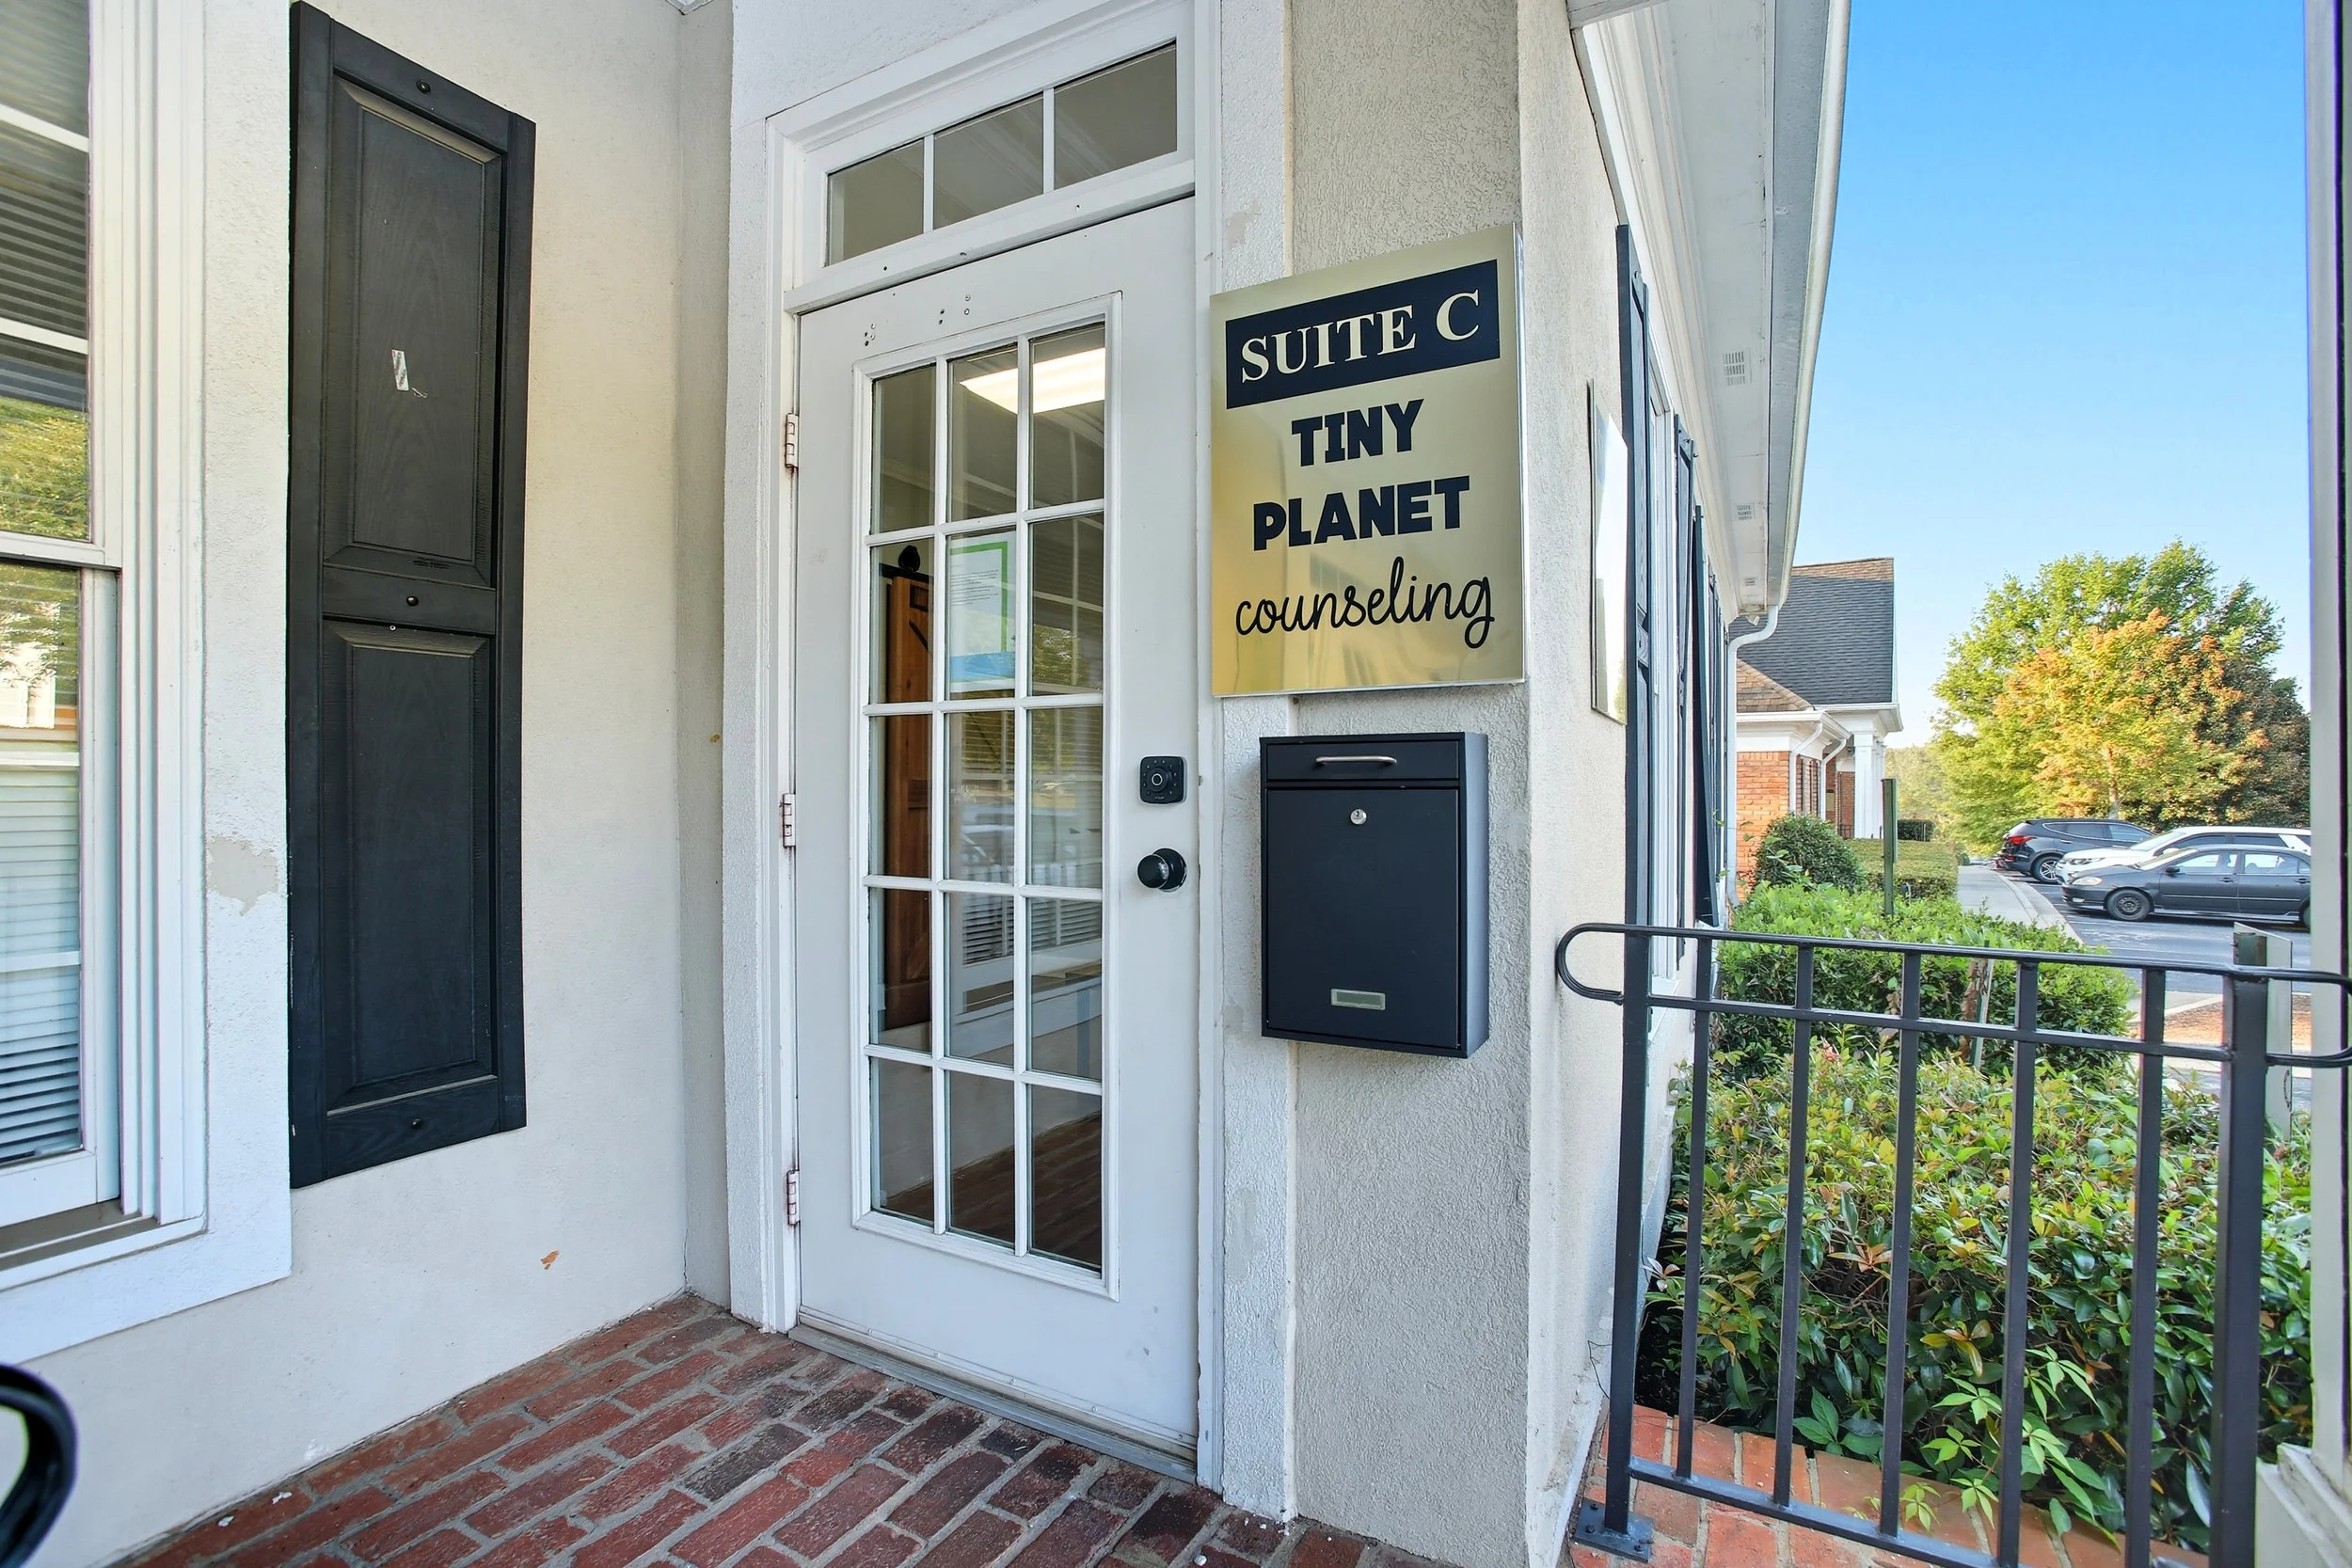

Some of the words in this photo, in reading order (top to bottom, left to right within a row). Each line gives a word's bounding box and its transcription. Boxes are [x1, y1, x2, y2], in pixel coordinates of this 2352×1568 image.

[1241, 304, 1417, 383] SUITE
[1436, 289, 1480, 341] C
[1292, 399, 1423, 467] TINY
[1253, 475, 1470, 551] PLANET
[1235, 556, 1495, 649] counseling
